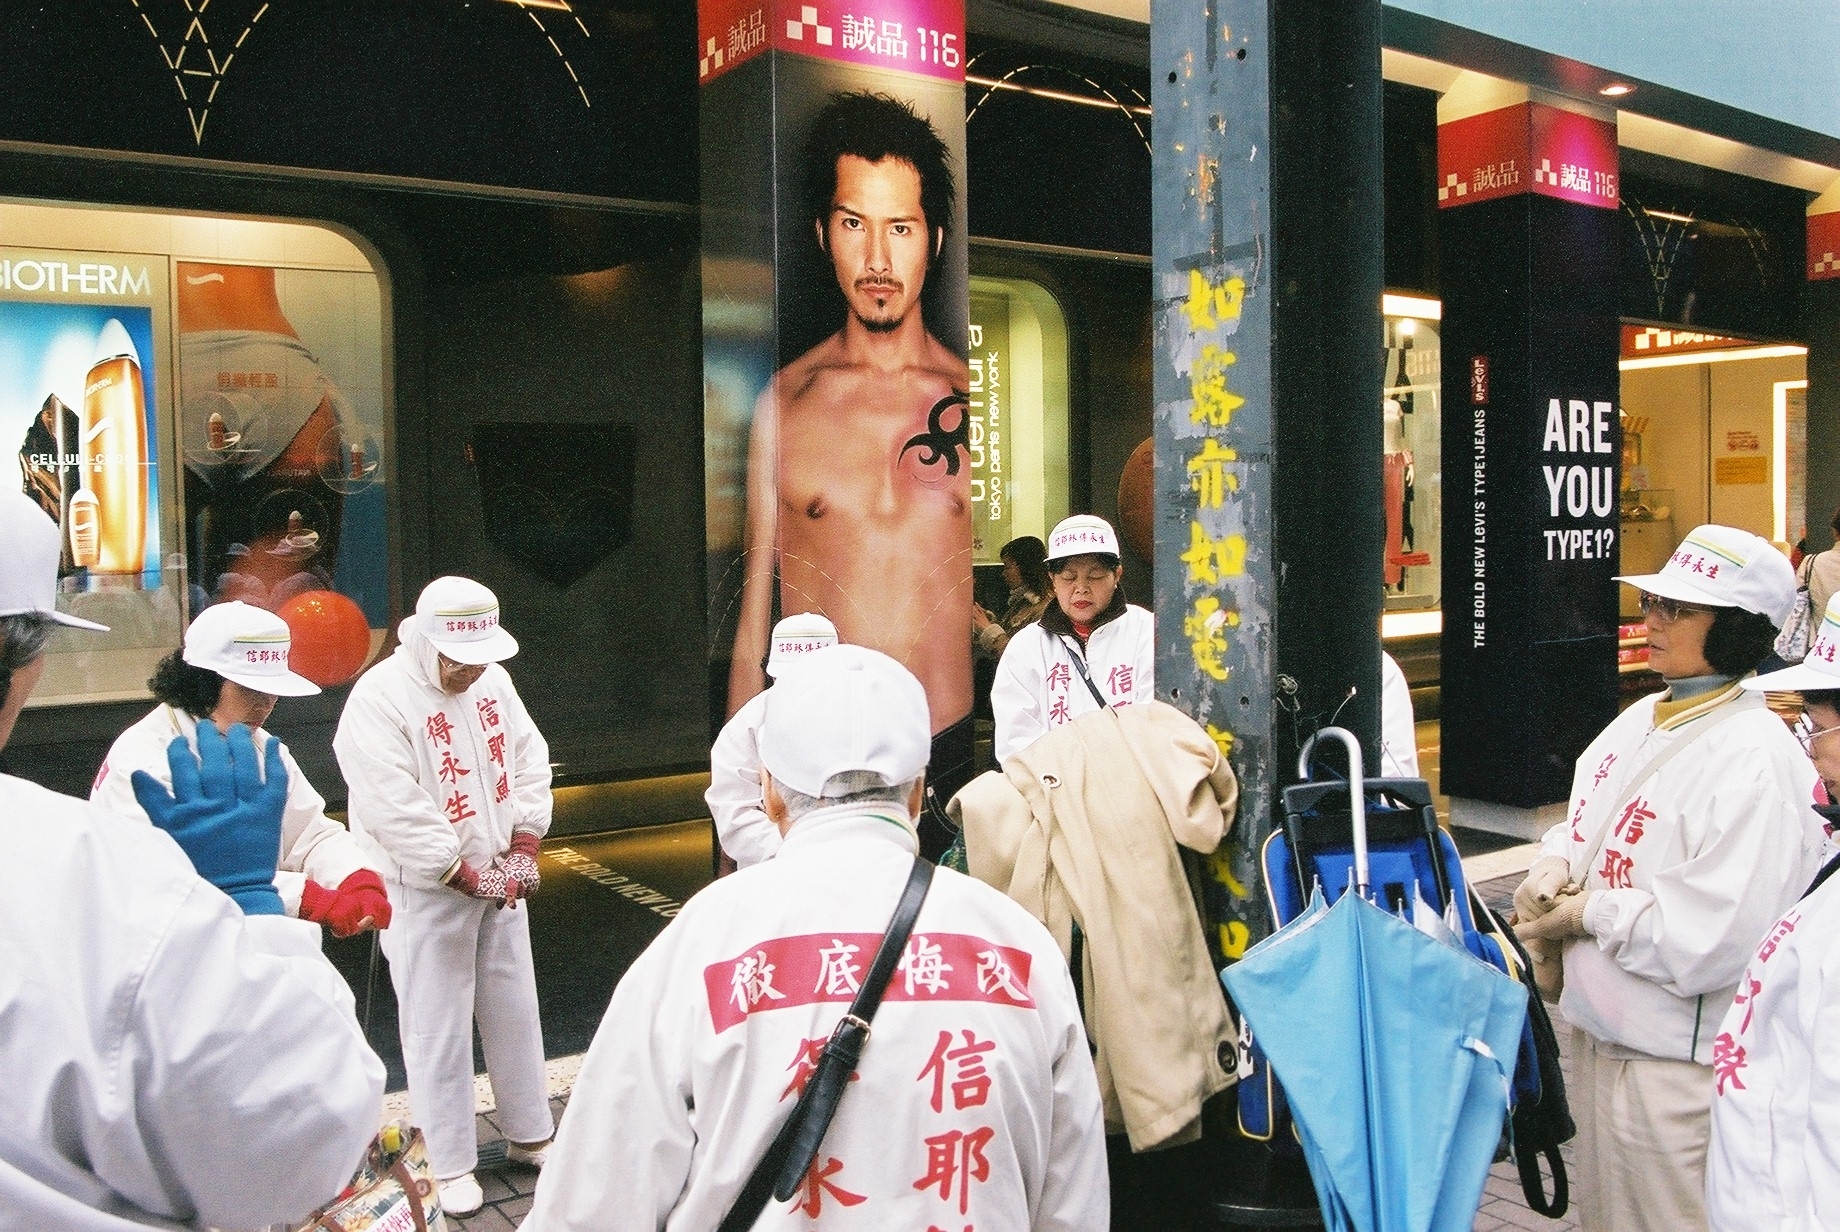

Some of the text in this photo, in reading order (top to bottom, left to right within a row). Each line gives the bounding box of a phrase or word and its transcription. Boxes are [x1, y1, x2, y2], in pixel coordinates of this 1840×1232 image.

[727, 9, 766, 61] 誠品
[841, 14, 960, 68] 誠品 116
[1472, 159, 1520, 193] 誠品
[1560, 163, 1616, 199] 誠品 116
[0, 259, 152, 296] IOTHERM
[1542, 398, 1612, 453] ARE
[988, 432, 1001, 473] paris
[989, 477, 1002, 521] tokyo
[1542, 465, 1613, 519] YOU
[1474, 546, 1485, 578] NEW
[1543, 528, 1614, 561] TYPE1?
[1474, 582, 1485, 617] BOLD
[1474, 621, 1485, 648] THE
[1814, 634, 1836, 663] 永生
[1106, 664, 1134, 709] 信
[426, 711, 477, 825] 得永生
[543, 847, 591, 866] THE
[570, 862, 629, 886] BOLD
[610, 883, 674, 905] NEW
[729, 936, 1029, 1013] 徹底悔改
[912, 1029, 997, 1232] 信耶
